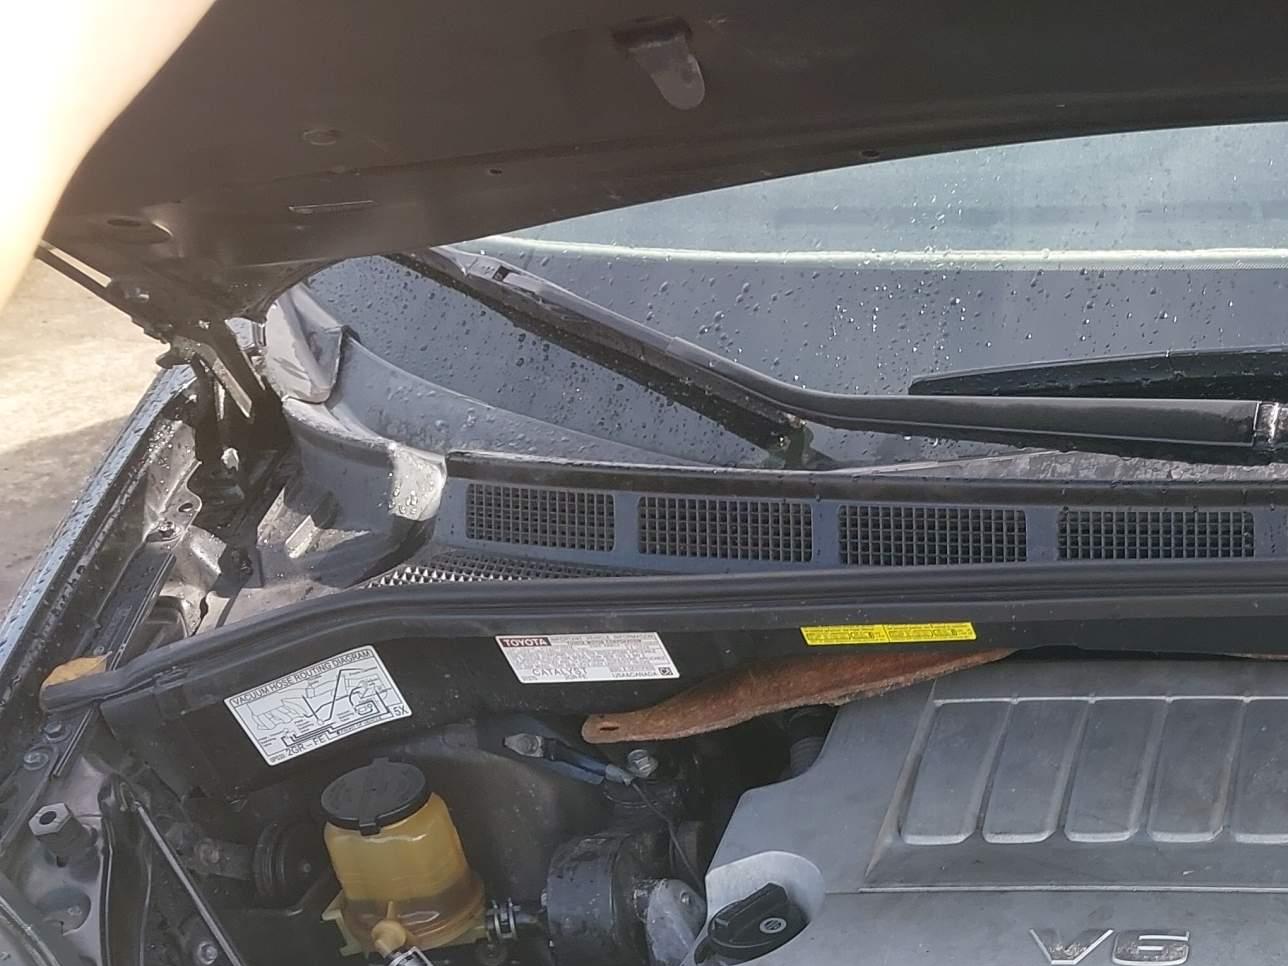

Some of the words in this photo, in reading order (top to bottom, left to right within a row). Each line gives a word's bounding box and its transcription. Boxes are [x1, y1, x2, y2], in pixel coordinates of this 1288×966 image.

[503, 638, 547, 647] TOYOTA
[231, 686, 270, 706] VACUUM
[270, 676, 295, 692] HOSE
[294, 662, 333, 682] ROUTING
[332, 650, 372, 669] DIAGRAM
[532, 667, 588, 677] CATALYST
[393, 705, 409, 717] 5X
[1029, 929, 1190, 966] V6
